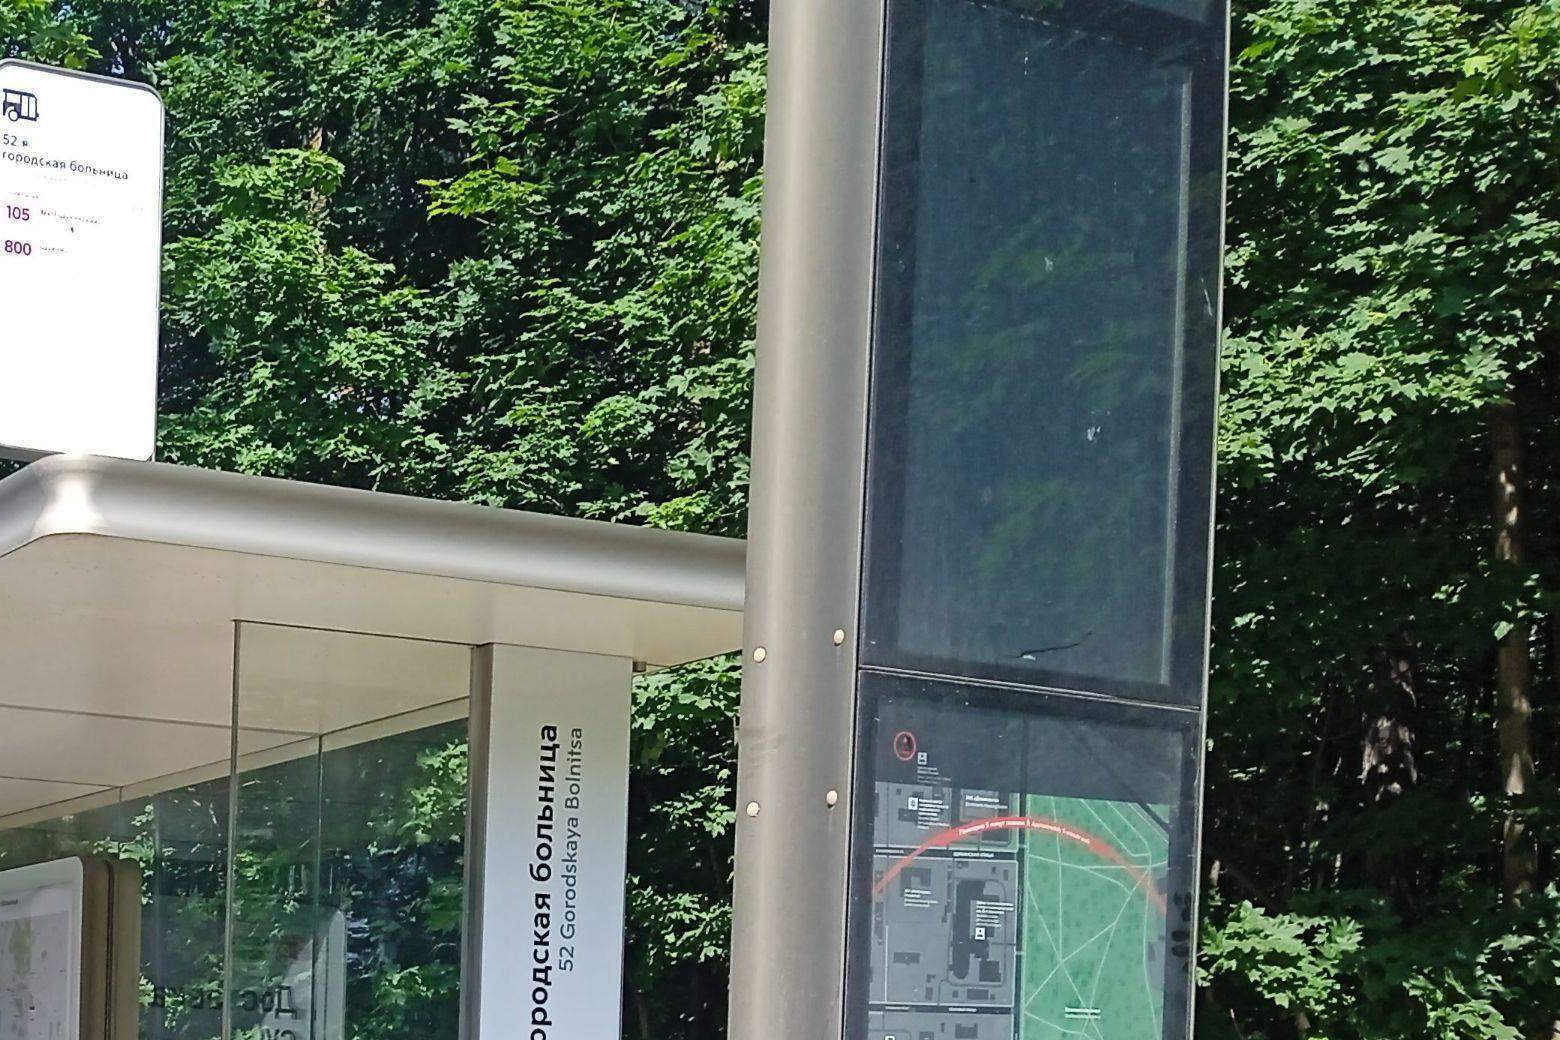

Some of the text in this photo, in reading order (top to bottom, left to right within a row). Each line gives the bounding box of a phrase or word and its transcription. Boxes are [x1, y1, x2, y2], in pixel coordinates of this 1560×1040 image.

[2, 151, 66, 169] городская
[70, 160, 129, 180] больница
[6, 205, 30, 221] 105
[4, 239, 31, 256] 800
[530, 725, 559, 882] больница
[558, 727, 582, 972] 52 Gorodskaya Bolnitsa
